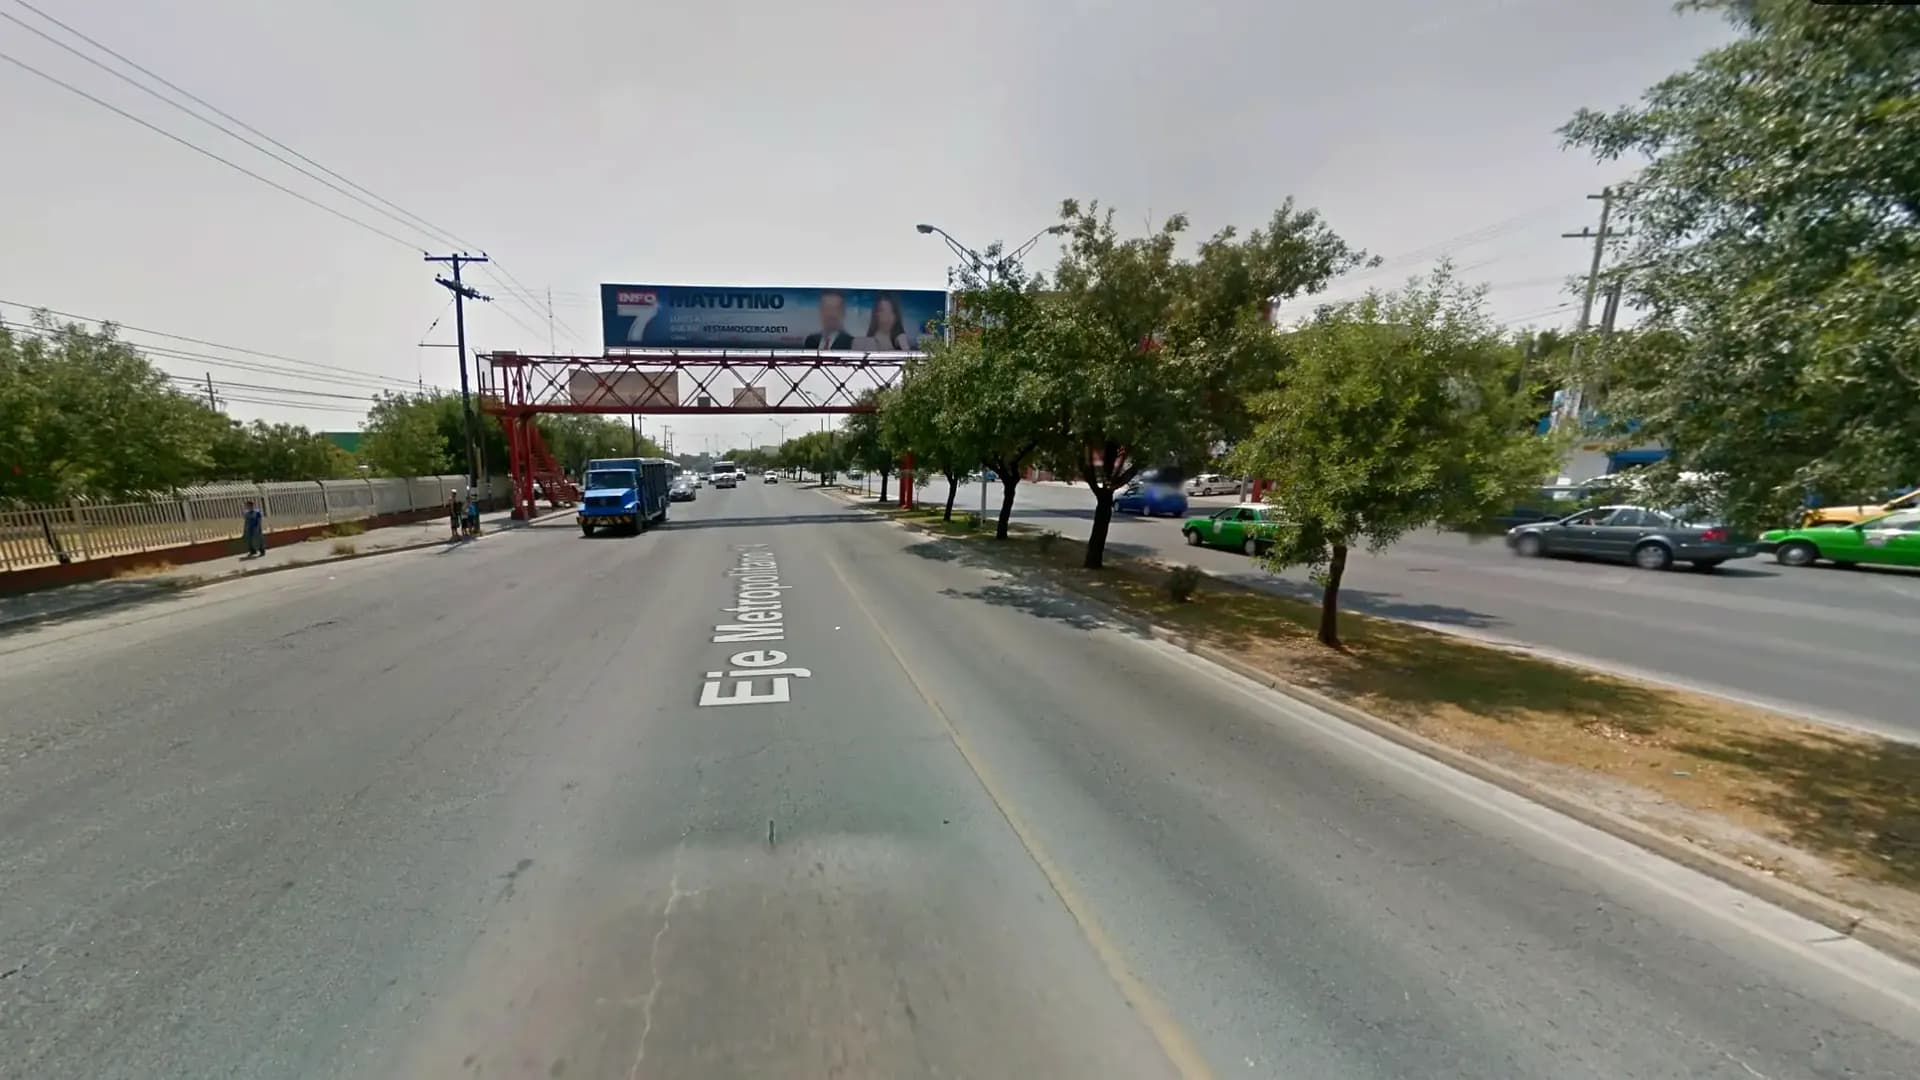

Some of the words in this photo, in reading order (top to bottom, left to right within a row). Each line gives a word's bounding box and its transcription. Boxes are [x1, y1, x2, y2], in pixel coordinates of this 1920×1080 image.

[618, 292, 656, 304] INFO
[670, 292, 784, 310] MATUTINO
[617, 304, 658, 342] 7
